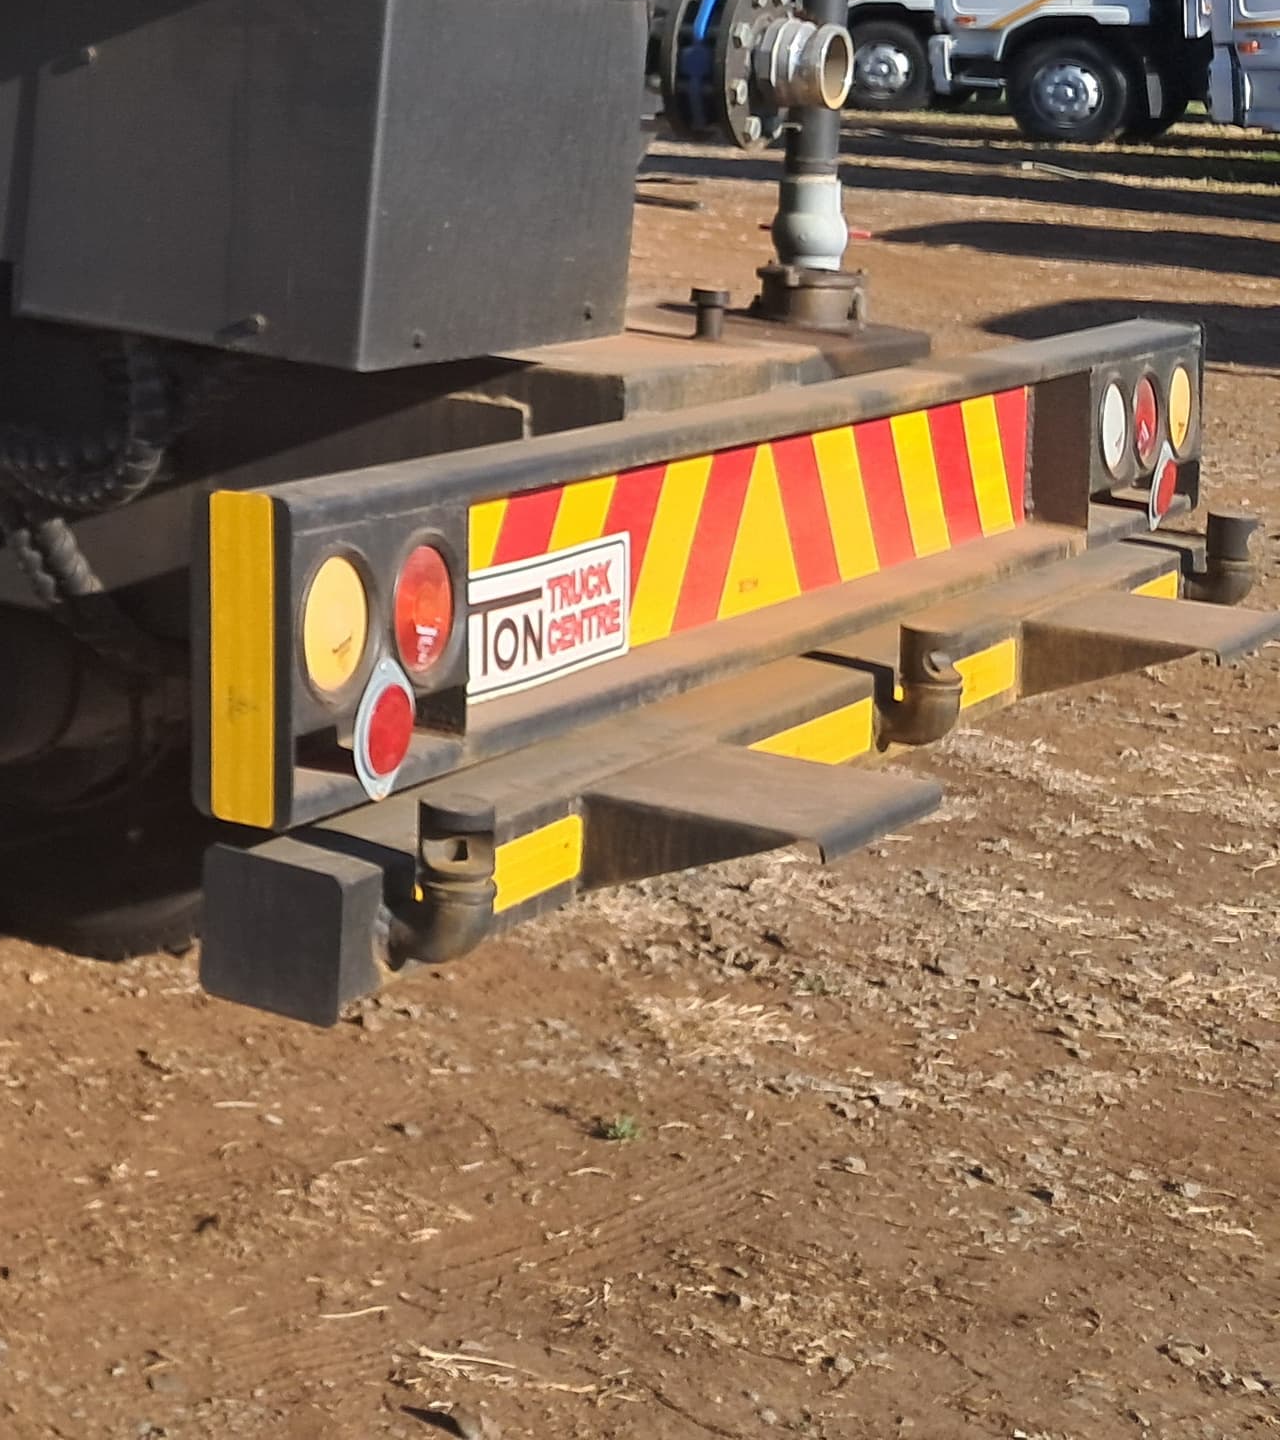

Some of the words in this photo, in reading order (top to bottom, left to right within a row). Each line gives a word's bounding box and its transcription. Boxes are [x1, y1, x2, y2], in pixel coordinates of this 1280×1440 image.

[546, 559, 612, 613] TRUCK
[468, 587, 543, 676] TON
[546, 598, 622, 656] CENTRE
